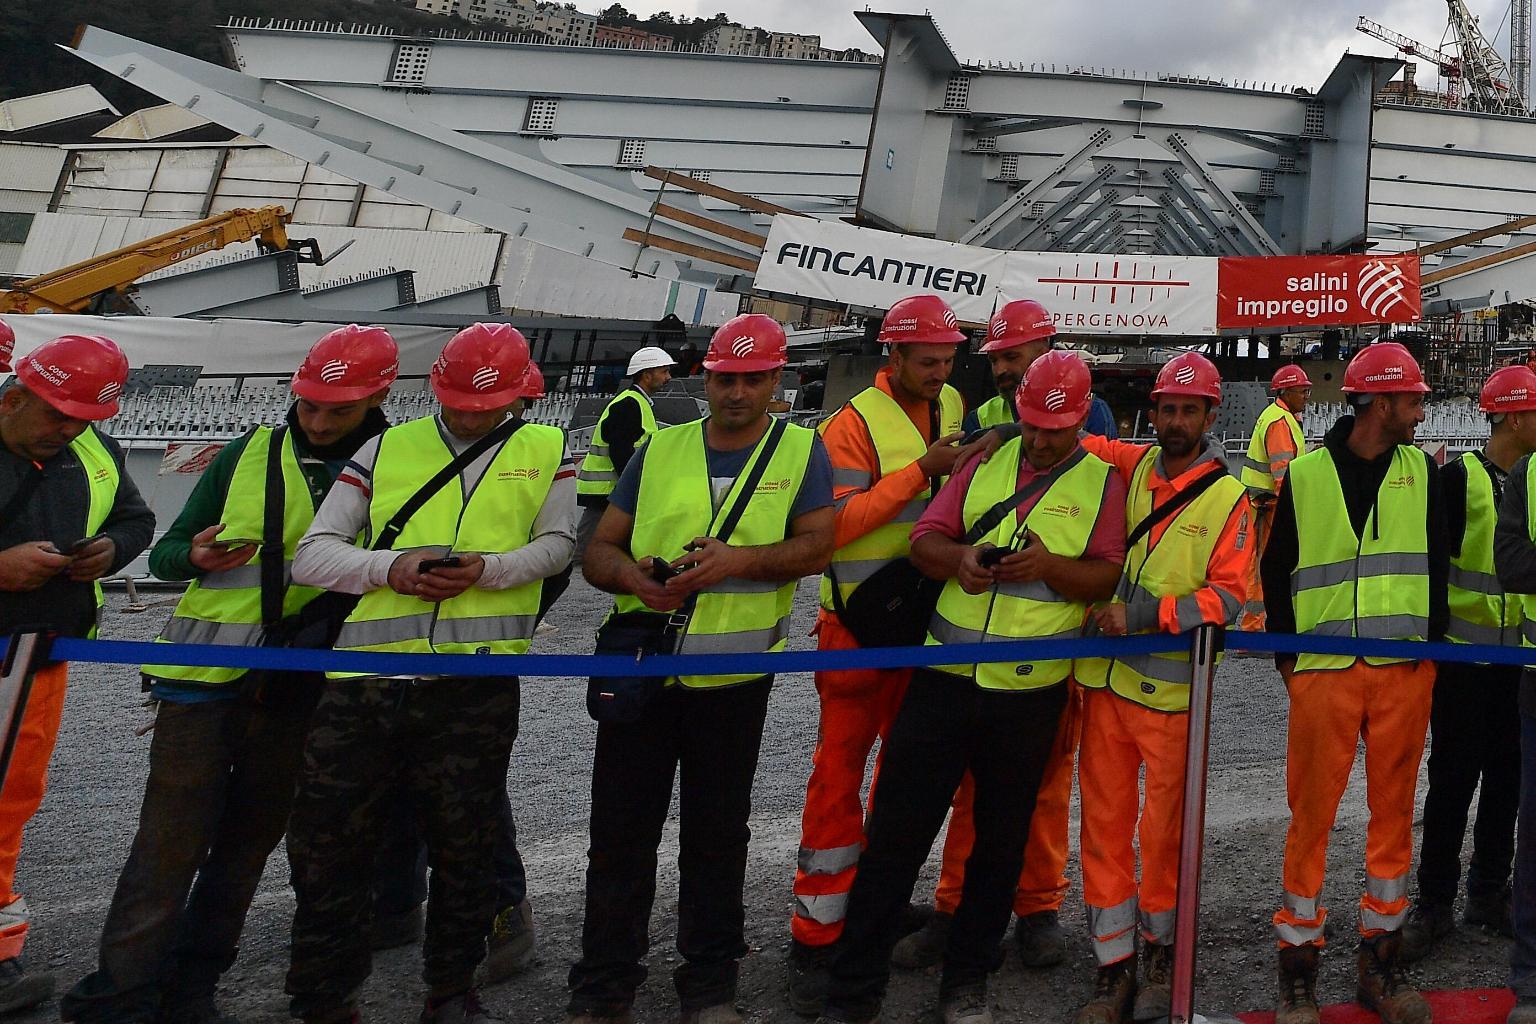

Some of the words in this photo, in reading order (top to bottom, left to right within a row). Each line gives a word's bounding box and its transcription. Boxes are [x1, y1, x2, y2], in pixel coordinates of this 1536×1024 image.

[777, 242, 987, 296] FINCANTIERI
[1286, 272, 1349, 292] salini
[1236, 294, 1349, 319] impregilo
[899, 317, 918, 325] cossi
[1052, 313, 1169, 327] PERGENOVA
[1365, 373, 1403, 382] costruzioni
[1510, 387, 1528, 395] cossi
